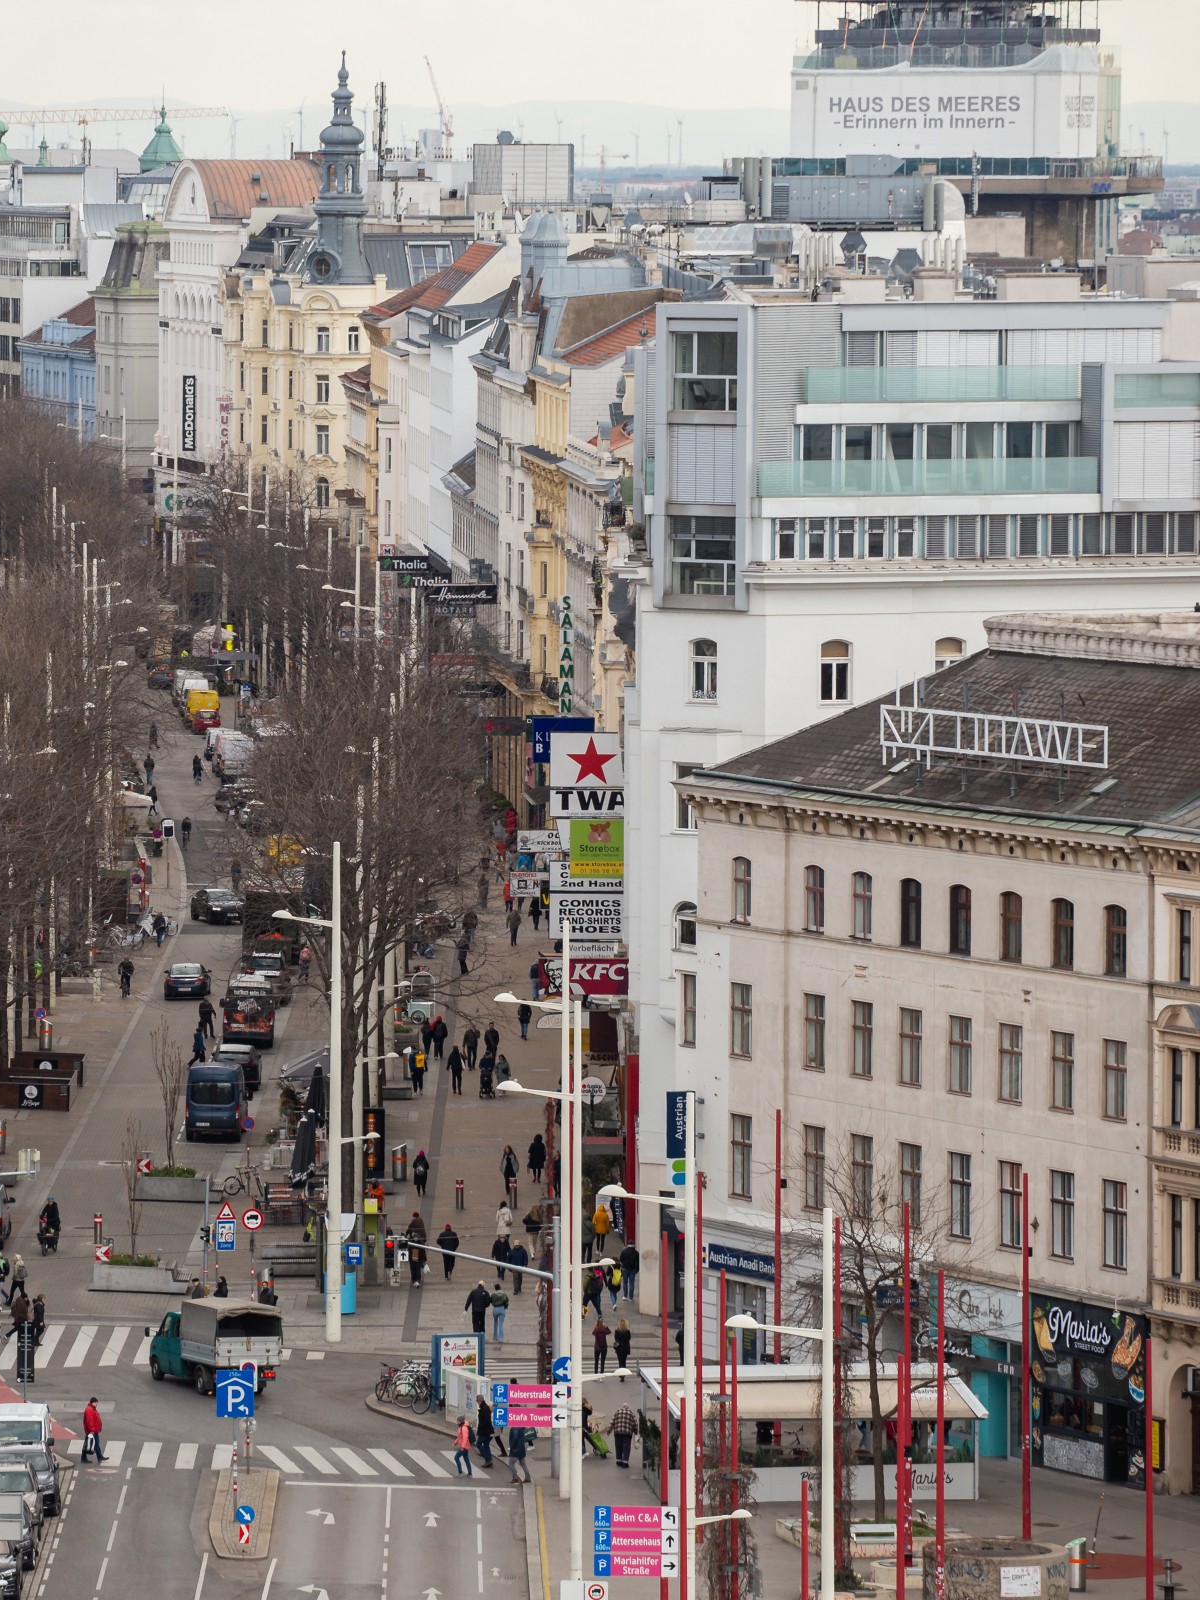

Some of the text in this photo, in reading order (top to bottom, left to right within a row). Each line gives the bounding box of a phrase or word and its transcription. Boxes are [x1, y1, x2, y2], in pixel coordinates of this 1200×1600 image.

[829, 95, 1021, 113] HAUS DES MEERES
[923, 114, 944, 128] im
[949, 115, 1005, 128] Innern
[184, 377, 195, 449] McDonald's
[392, 559, 428, 569] Thalia
[412, 577, 449, 587] Thalia
[560, 596, 574, 717] SALAMAN
[555, 790, 624, 811] TWA
[560, 880, 622, 888] 2nd Hand
[559, 899, 621, 908] COMICS
[559, 908, 621, 917] RECORDS
[571, 963, 626, 981] KFC
[674, 1096, 684, 1140] Austrian
[709, 1251, 738, 1267] Austrian
[738, 1257, 759, 1271] Anadi
[1049, 1306, 1112, 1348] Maria's
[1073, 1341, 1105, 1354] STREET FOOD
[227, 1385, 246, 1413] P
[509, 1389, 552, 1399] Kaiserstraße
[508, 1414, 528, 1422] Stafa
[530, 1414, 552, 1422] Tower
[801, 1471, 820, 1481] Piz
[613, 1513, 635, 1523] Beim
[611, 1538, 661, 1547] Atterseehaus
[613, 1556, 659, 1566] Mariahilfer
[622, 1566, 650, 1575] Straße
